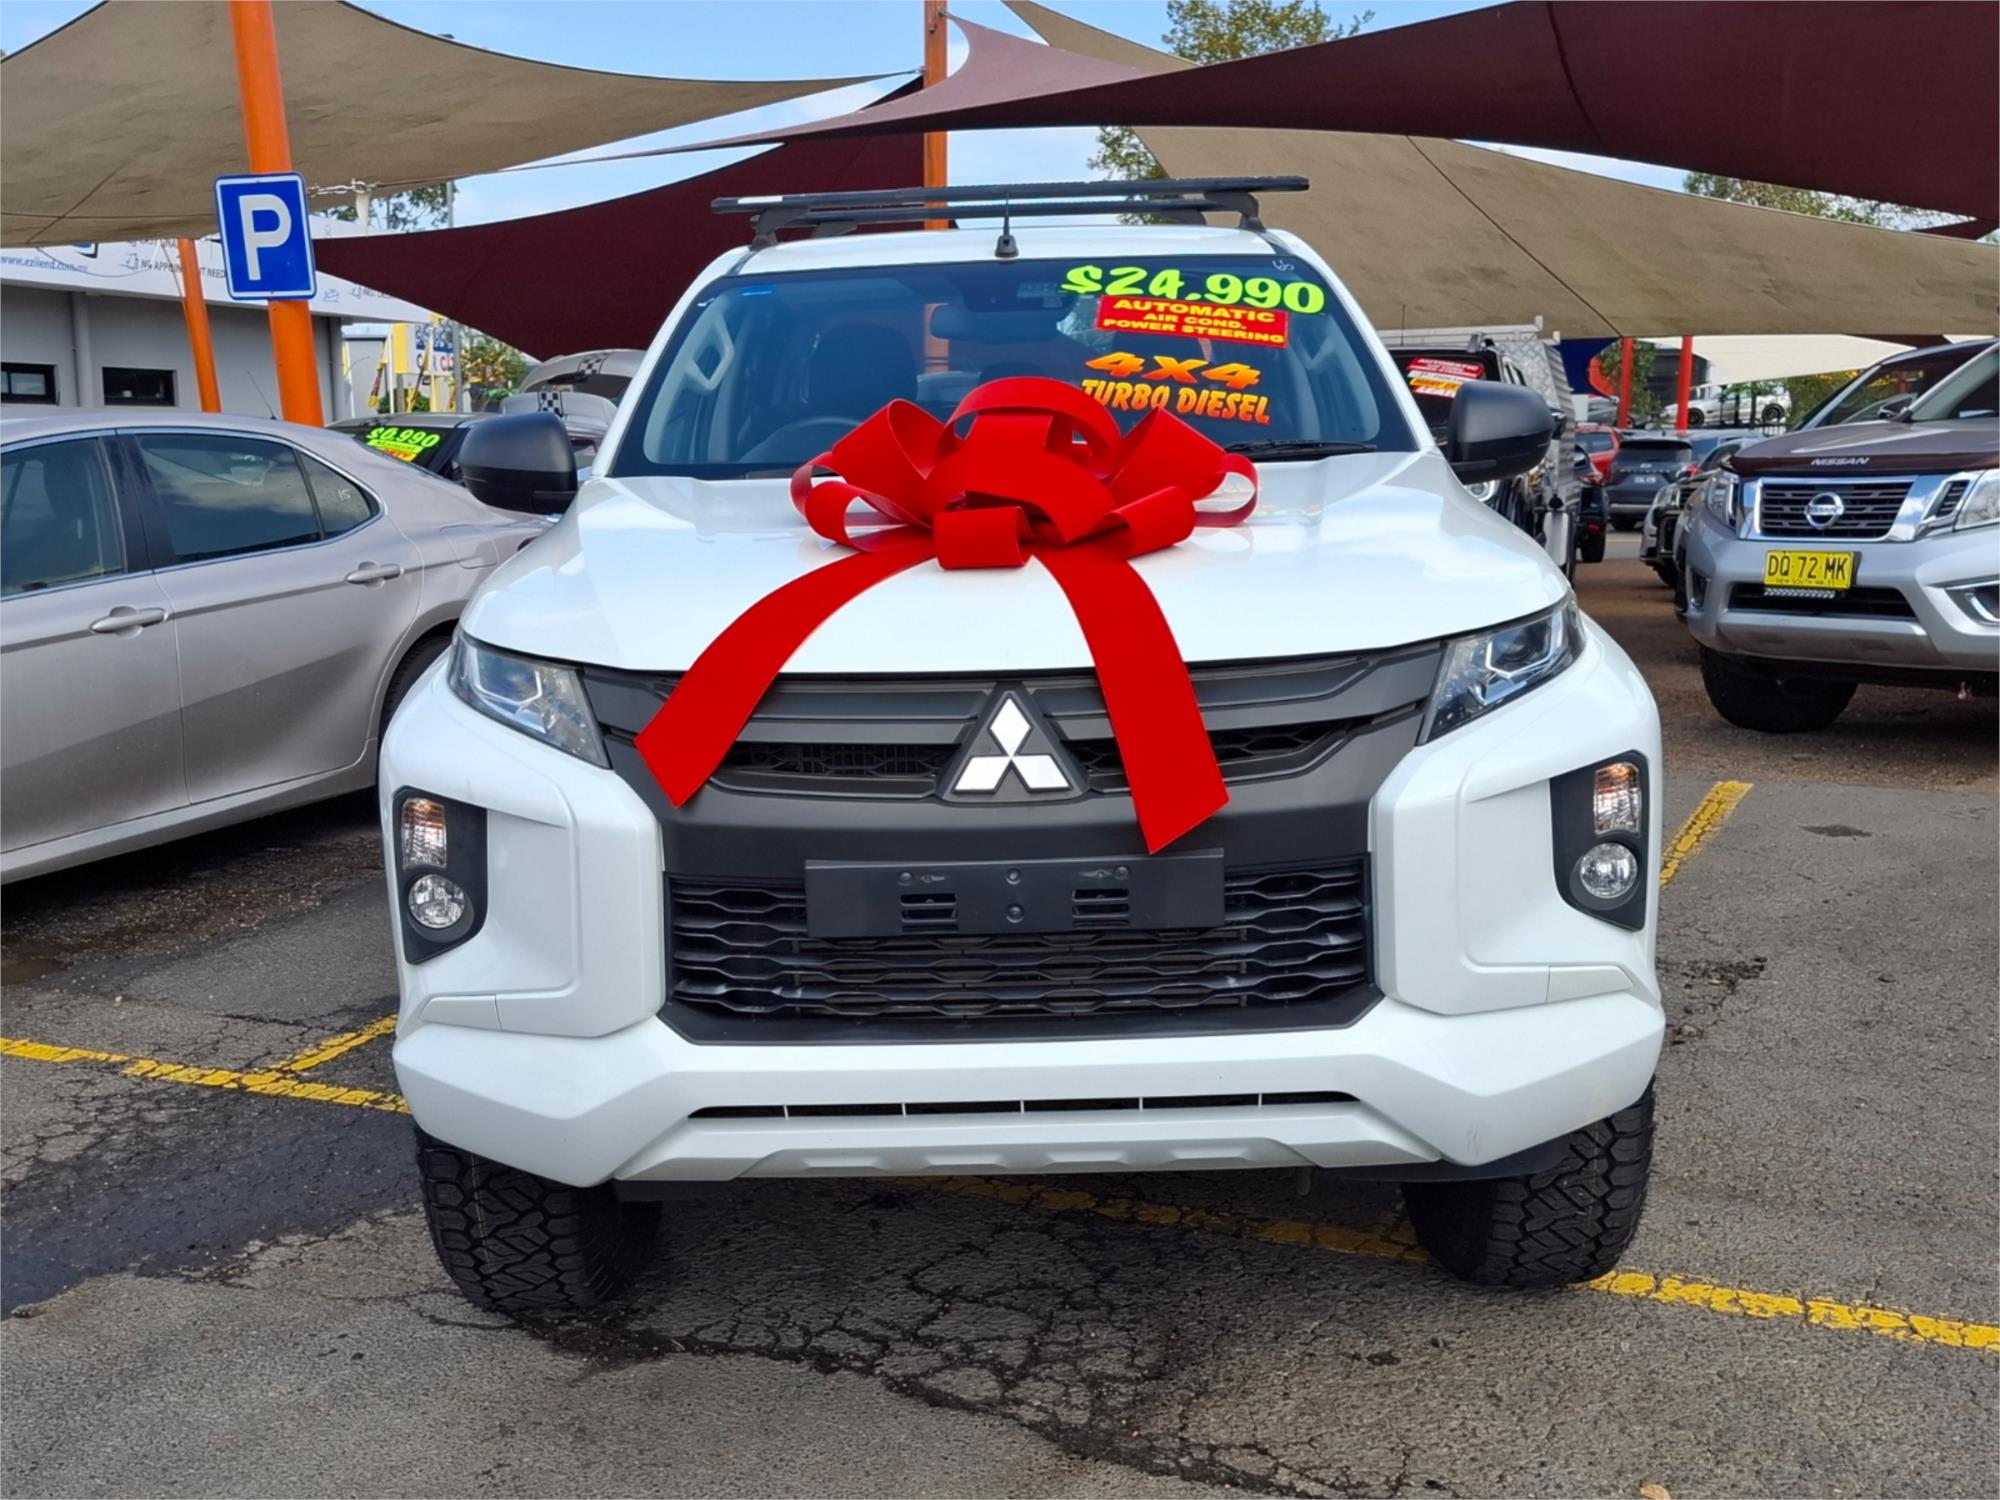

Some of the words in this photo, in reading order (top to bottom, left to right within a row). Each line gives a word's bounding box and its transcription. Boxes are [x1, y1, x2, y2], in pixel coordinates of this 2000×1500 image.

[238, 193, 292, 281] P
[1113, 299, 1276, 323] AUTOMATIC
[1143, 313, 1179, 322] AIR
[1184, 315, 1247, 330] COND.
[1103, 318, 1177, 332] POWER
[1181, 324, 1285, 344] STEERING
[1084, 351, 1262, 390] 4X4
[1081, 379, 1170, 411] TURBO
[1175, 386, 1271, 424] DIESEL
[1810, 457, 1871, 466] NISSAN
[1768, 555, 1791, 576] DQ
[1797, 556, 1818, 578] 72
[1824, 557, 1848, 580] MK
